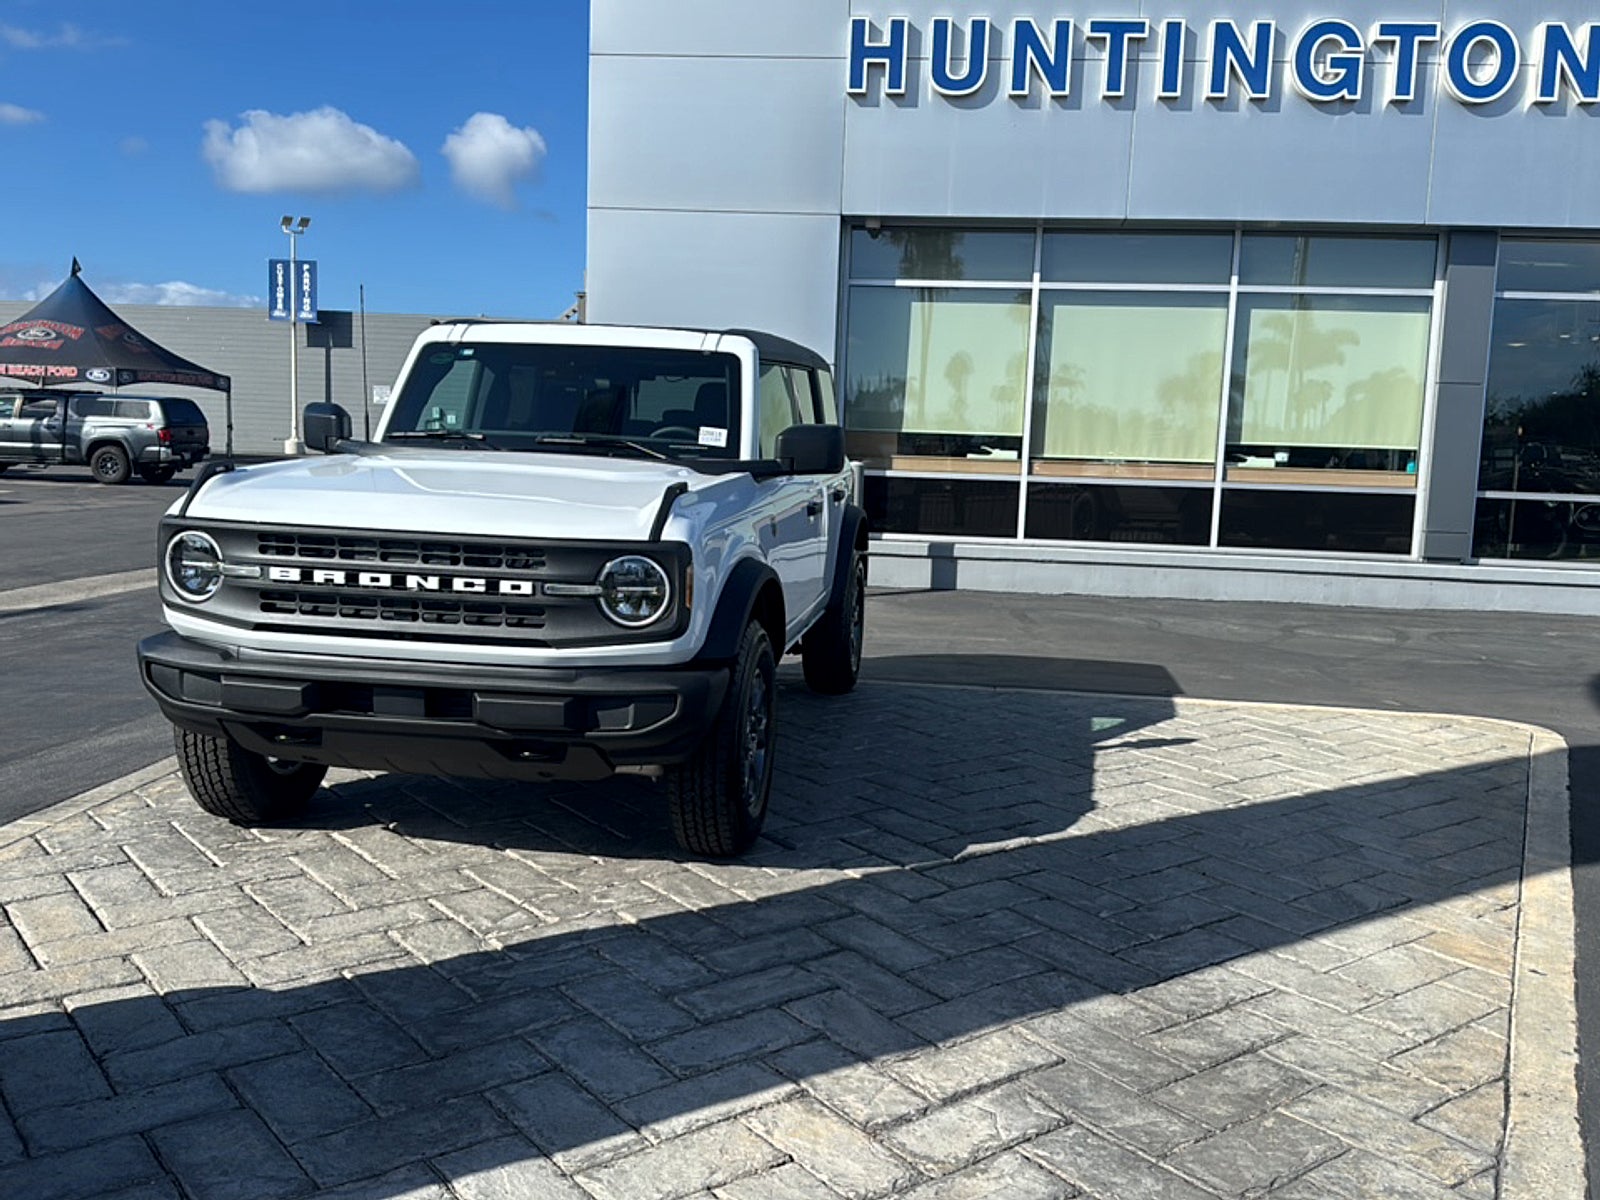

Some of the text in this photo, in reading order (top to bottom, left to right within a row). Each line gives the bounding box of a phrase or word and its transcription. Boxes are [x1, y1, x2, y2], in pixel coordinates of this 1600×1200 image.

[847, 16, 1600, 102] HUNTINGTON
[303, 263, 311, 311] PARKING
[7, 364, 46, 376] BEACH
[47, 366, 78, 377] FORD
[269, 566, 534, 594] BRONCO
